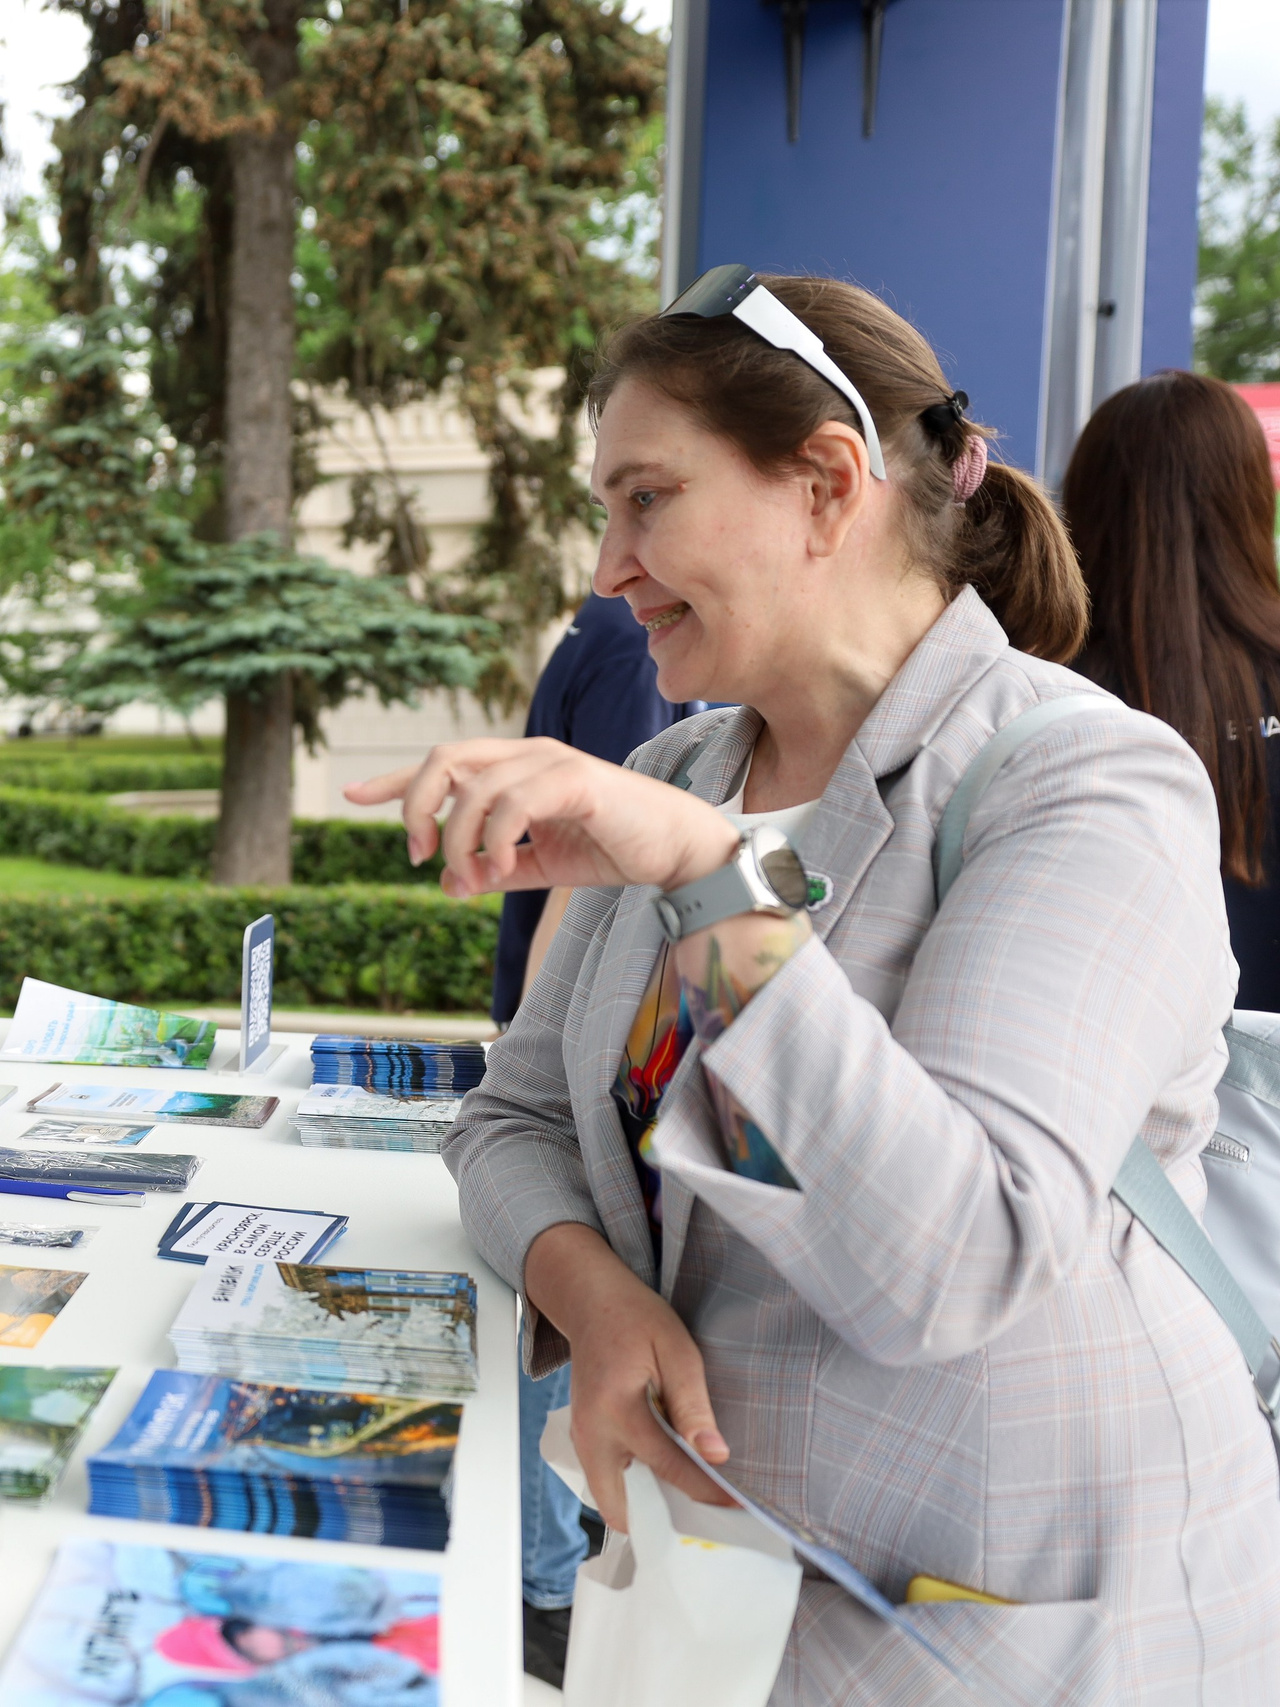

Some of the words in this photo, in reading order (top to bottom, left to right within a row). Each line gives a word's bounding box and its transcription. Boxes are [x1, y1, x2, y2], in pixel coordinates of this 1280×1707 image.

[233, 1246, 247, 1255] В
[242, 1223, 272, 1249] САМОМ
[254, 1230, 287, 1258] СЕРДЦЕ
[273, 1230, 308, 1261] РОССИИ
